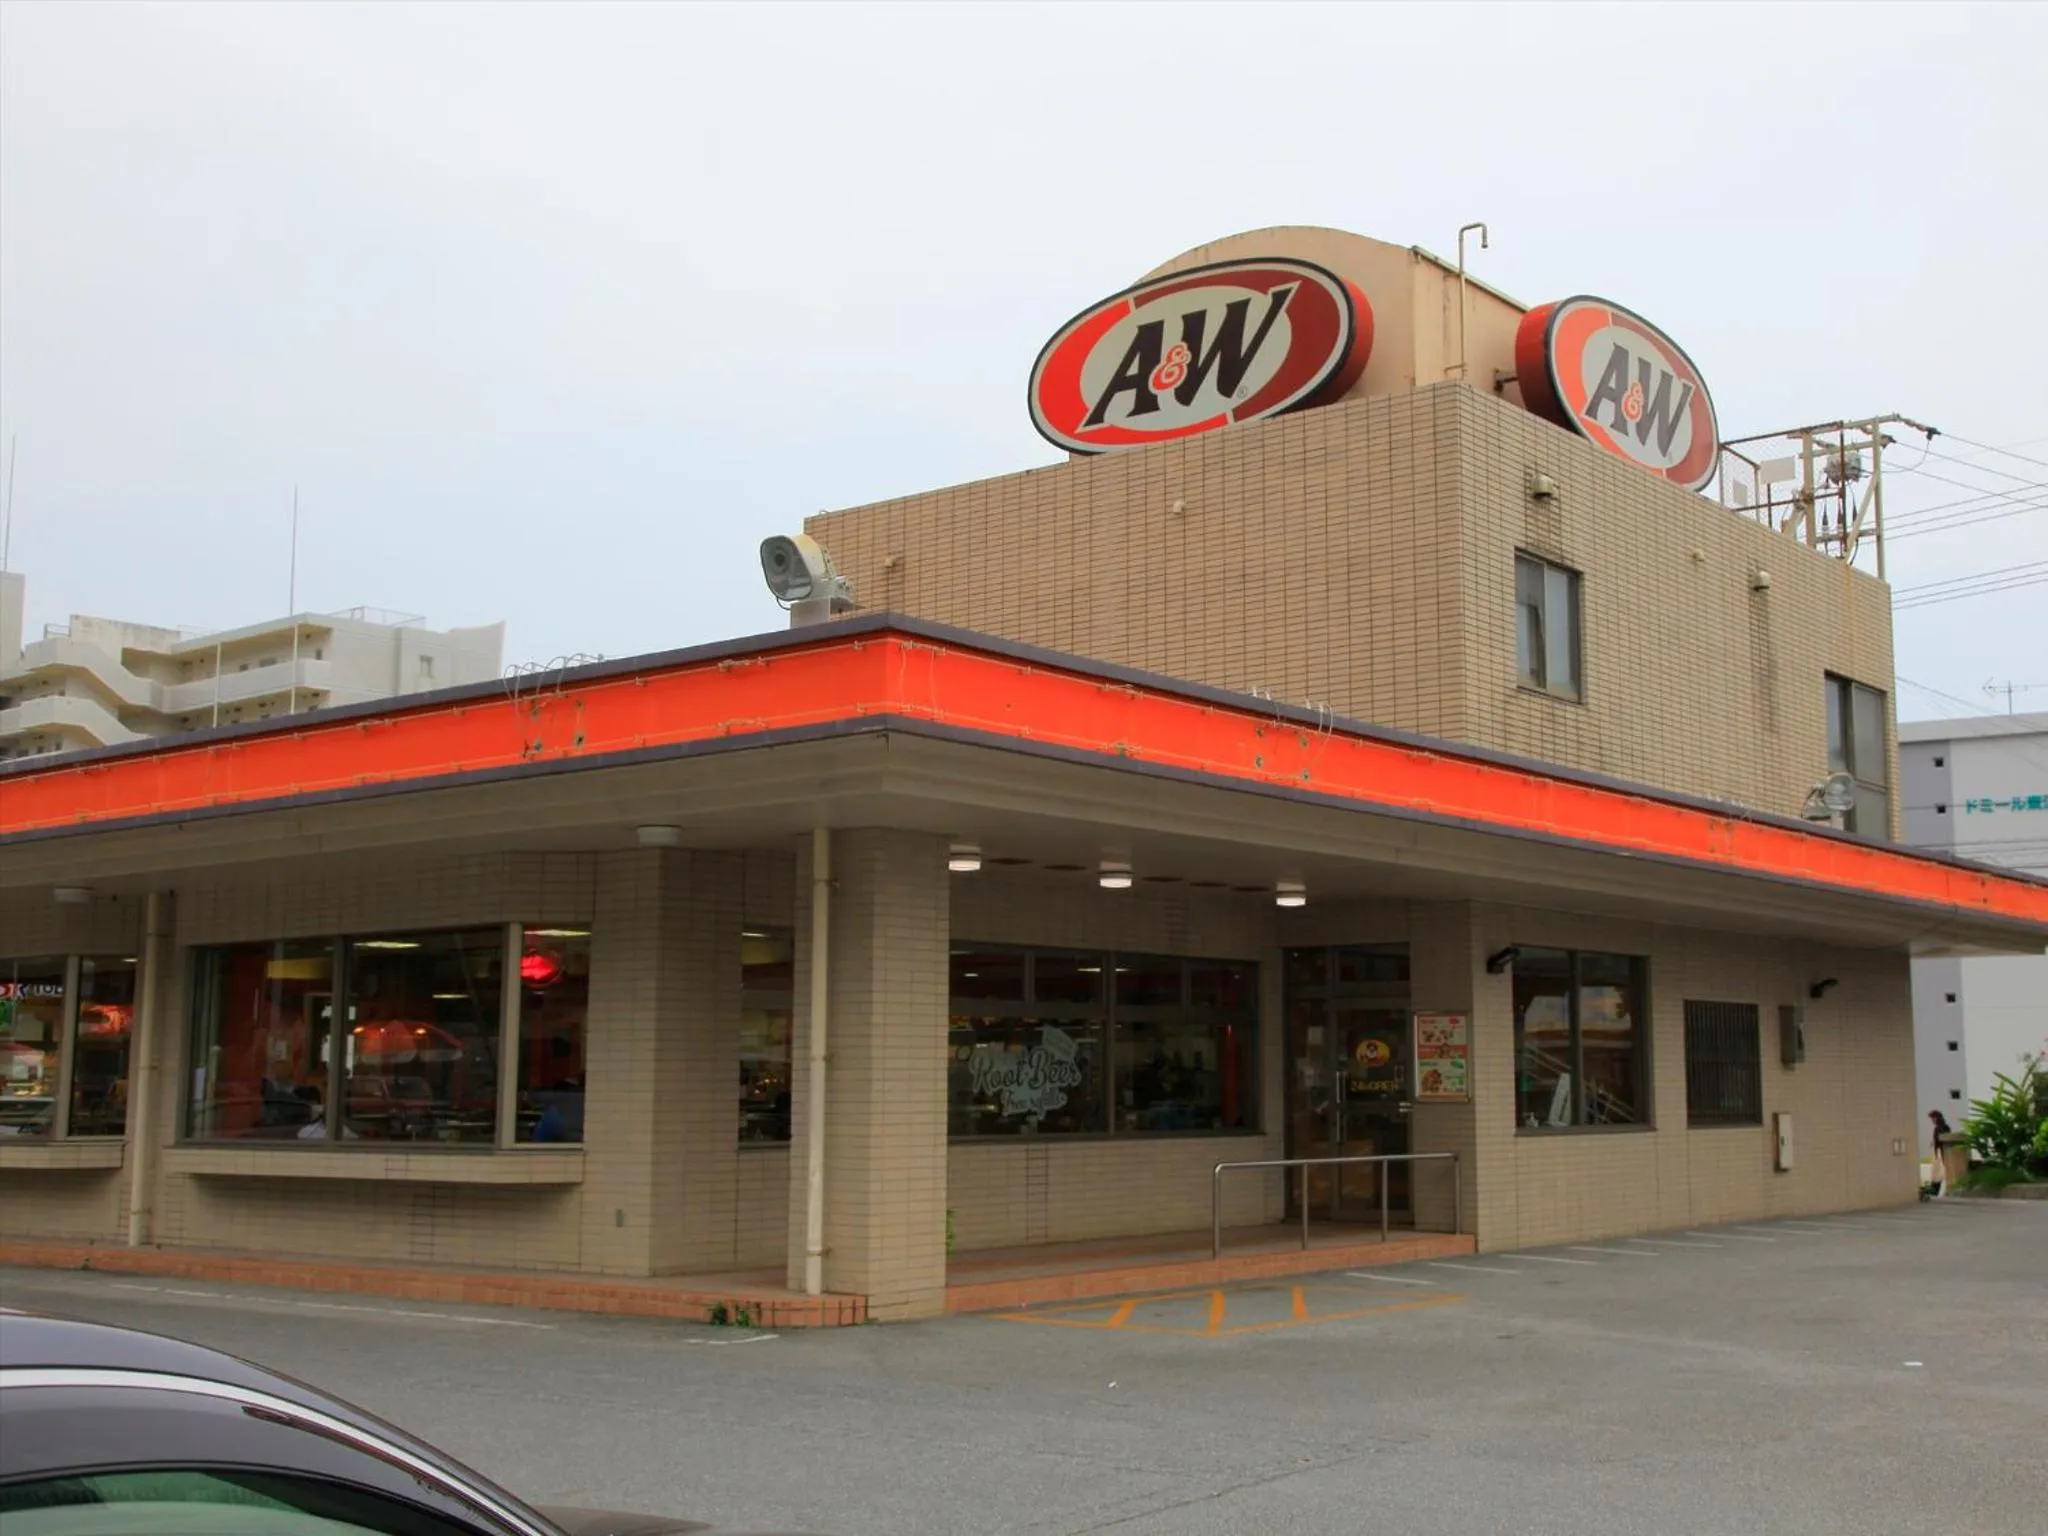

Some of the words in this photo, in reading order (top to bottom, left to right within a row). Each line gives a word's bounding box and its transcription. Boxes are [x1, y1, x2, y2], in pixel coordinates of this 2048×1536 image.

[1081, 286, 1294, 428] A&W
[1584, 341, 1694, 458] A&W
[1966, 794, 2048, 814] ドミール
[970, 1052, 1026, 1094] Root
[1028, 1048, 1081, 1090] Beer
